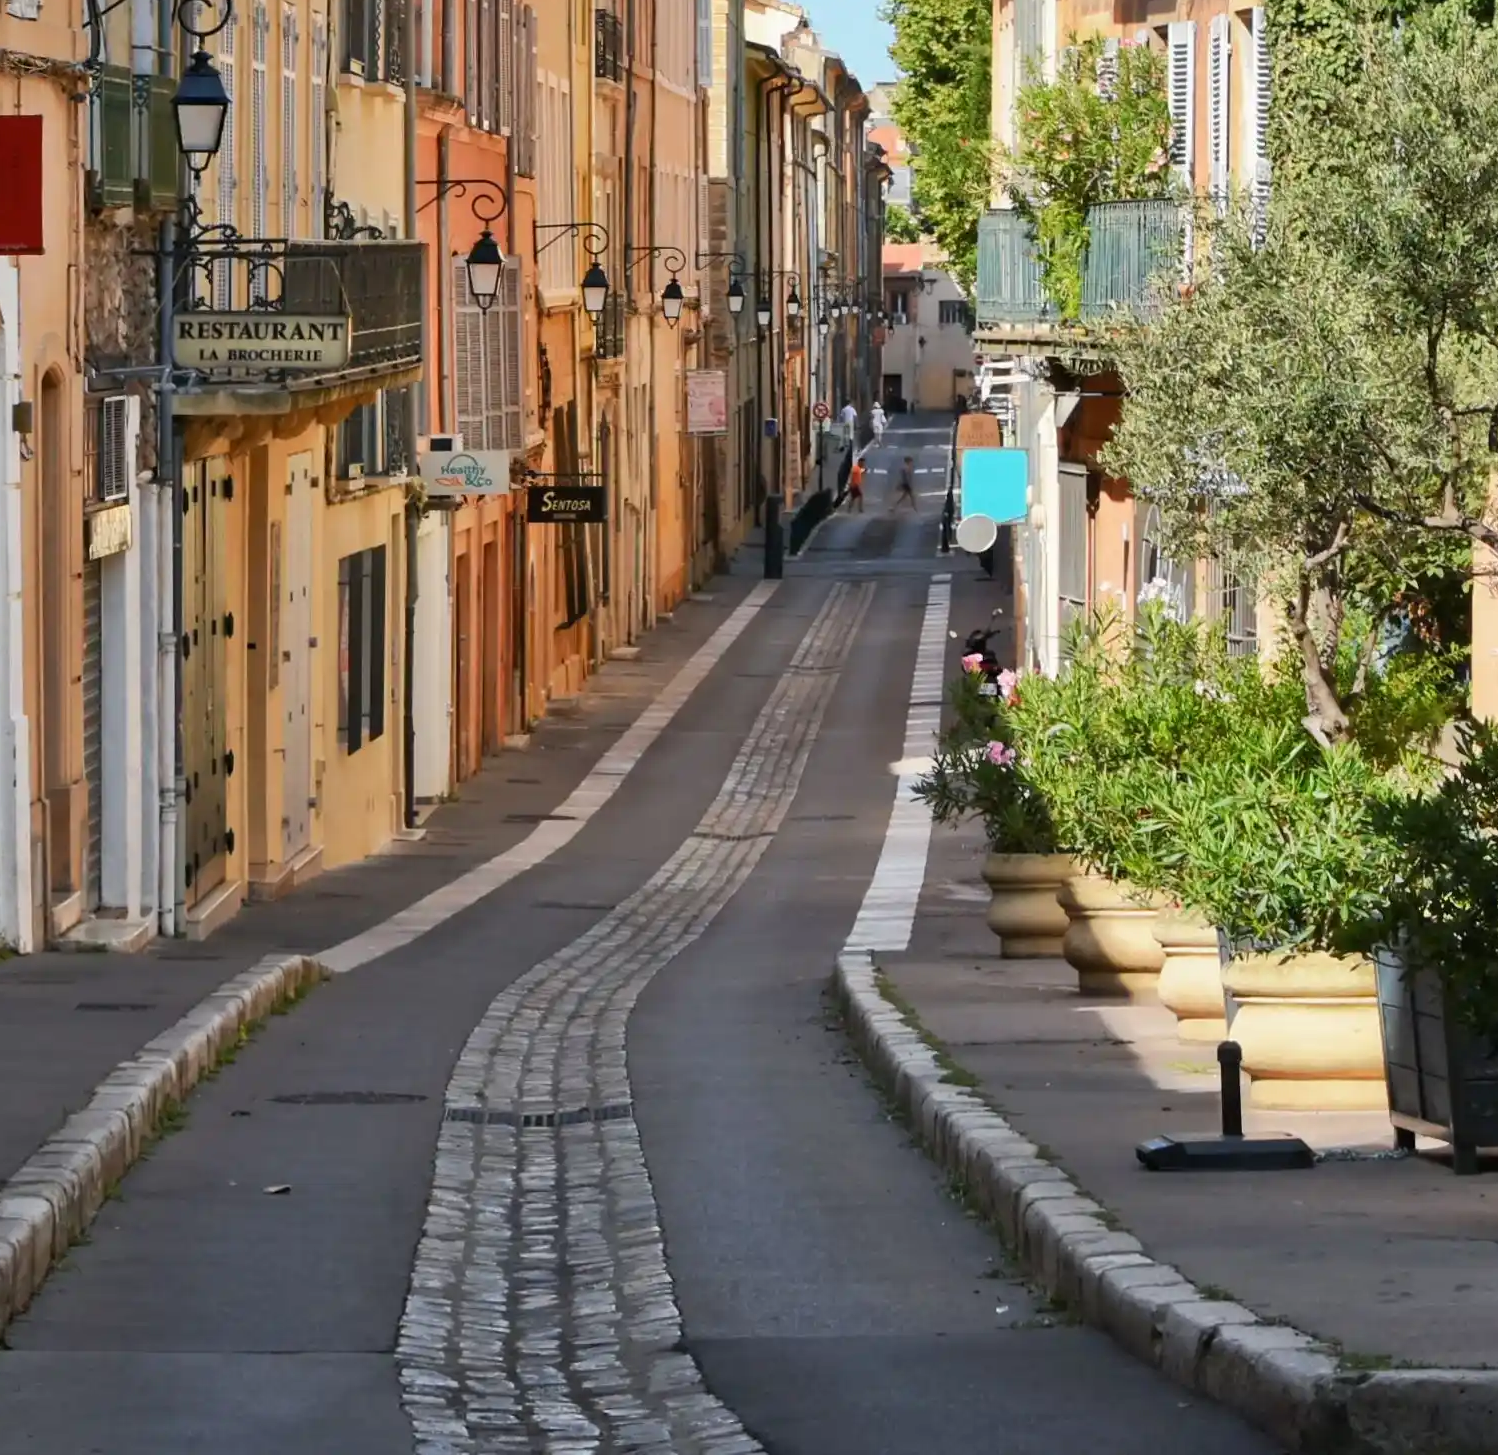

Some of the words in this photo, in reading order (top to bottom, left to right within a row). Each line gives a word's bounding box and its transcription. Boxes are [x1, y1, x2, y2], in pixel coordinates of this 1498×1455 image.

[178, 321, 344, 342] RESTAURANT
[199, 349, 219, 361] LA
[227, 349, 323, 362] BROCHERIE
